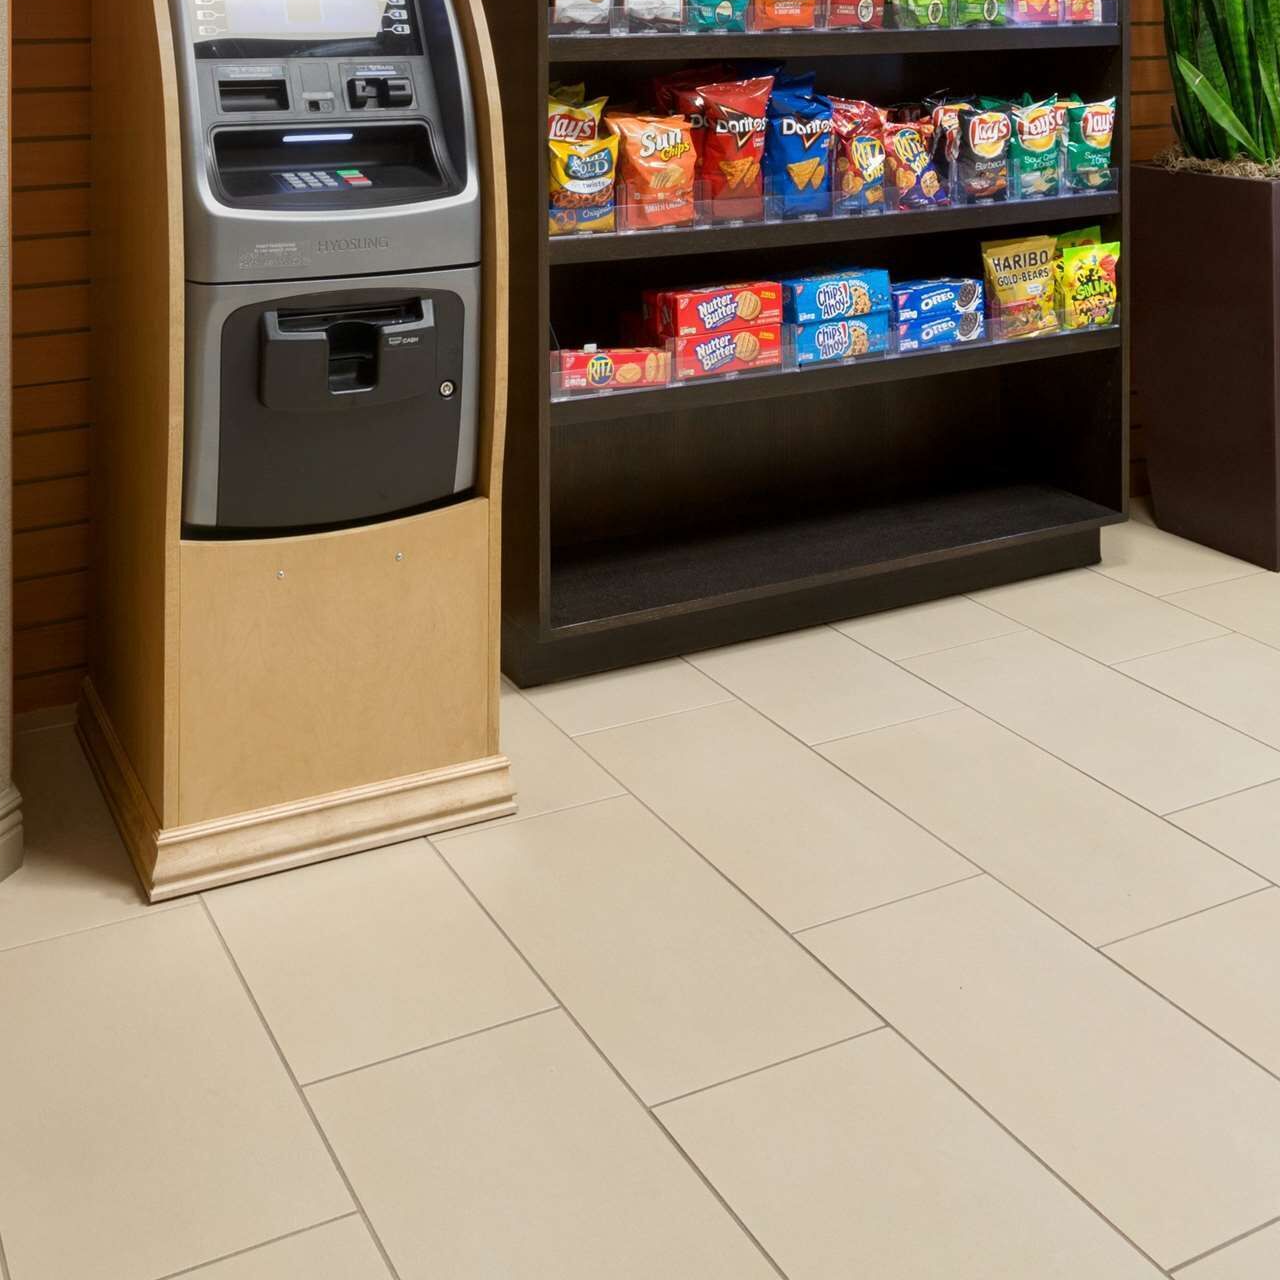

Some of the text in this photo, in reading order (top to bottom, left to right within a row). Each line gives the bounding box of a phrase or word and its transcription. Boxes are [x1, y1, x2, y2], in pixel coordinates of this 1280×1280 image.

[716, 116, 767, 136] Doritos
[782, 117, 834, 136] Doritos
[974, 115, 1011, 145] Lay's
[640, 122, 683, 158] Sun
[660, 141, 690, 161] Chips
[317, 237, 390, 253] HYOSUNG
[992, 250, 1049, 272] HARIBO
[697, 293, 735, 318] Nutter
[817, 285, 843, 306] Chips
[921, 291, 955, 311] OREO
[704, 303, 739, 328] Butter
[816, 325, 842, 345] Chips
[922, 321, 956, 341] OREO
[696, 334, 732, 358] Nutter
[702, 344, 737, 370] Butter
[588, 360, 612, 379] RITZ
